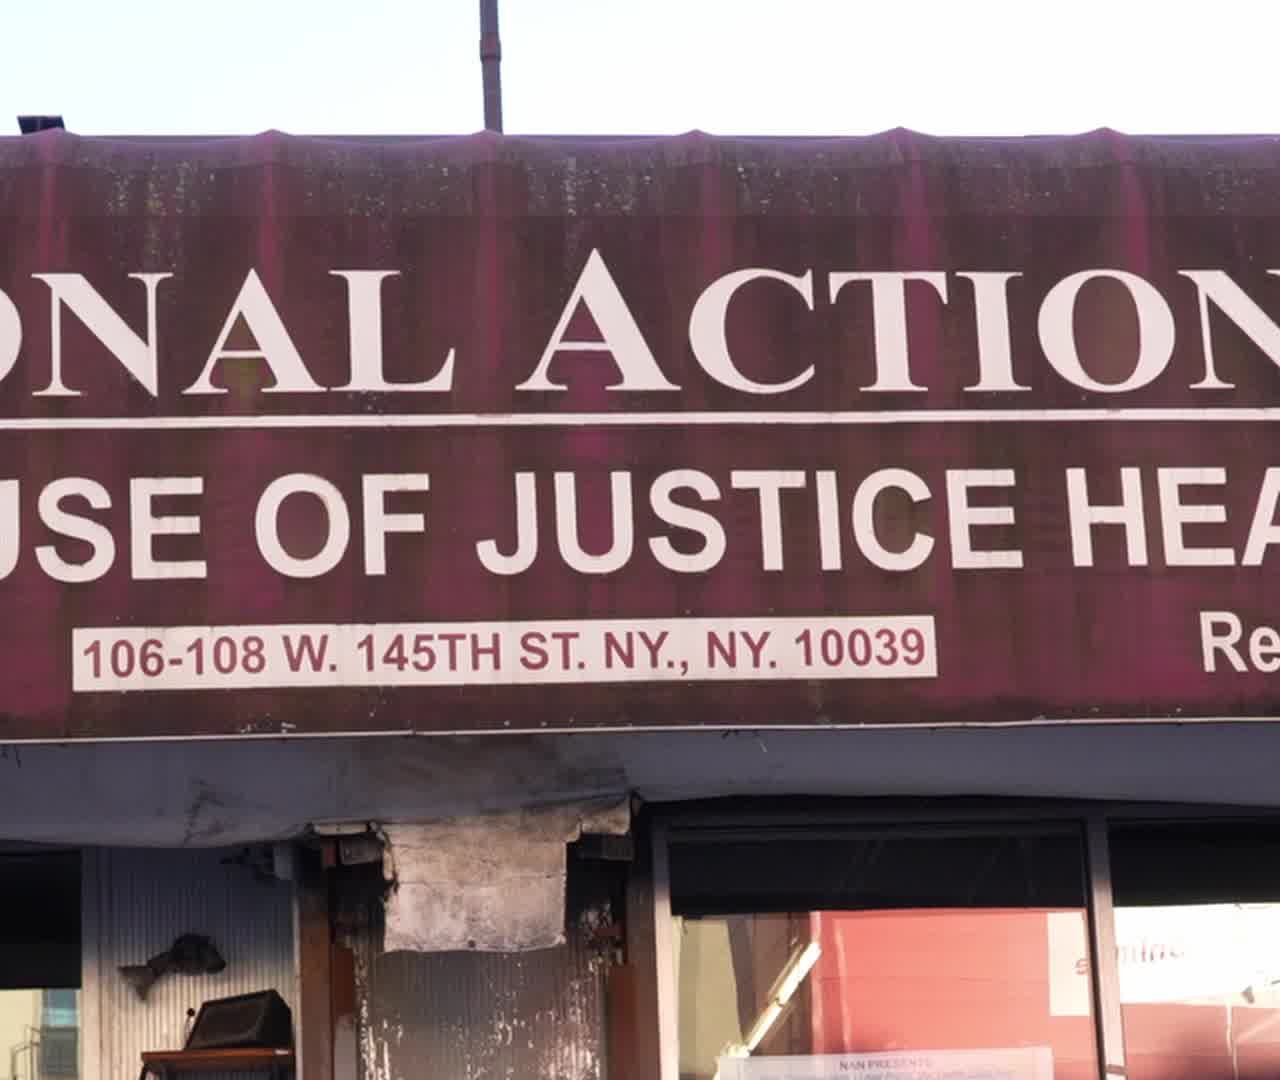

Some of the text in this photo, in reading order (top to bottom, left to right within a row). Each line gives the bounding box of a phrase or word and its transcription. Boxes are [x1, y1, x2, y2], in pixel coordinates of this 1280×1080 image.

[255, 473, 430, 578] OF
[476, 468, 1024, 575] JUSTICE
[82, 627, 926, 678] 106-108 W. 145TH ST. NY., NY. 10039
